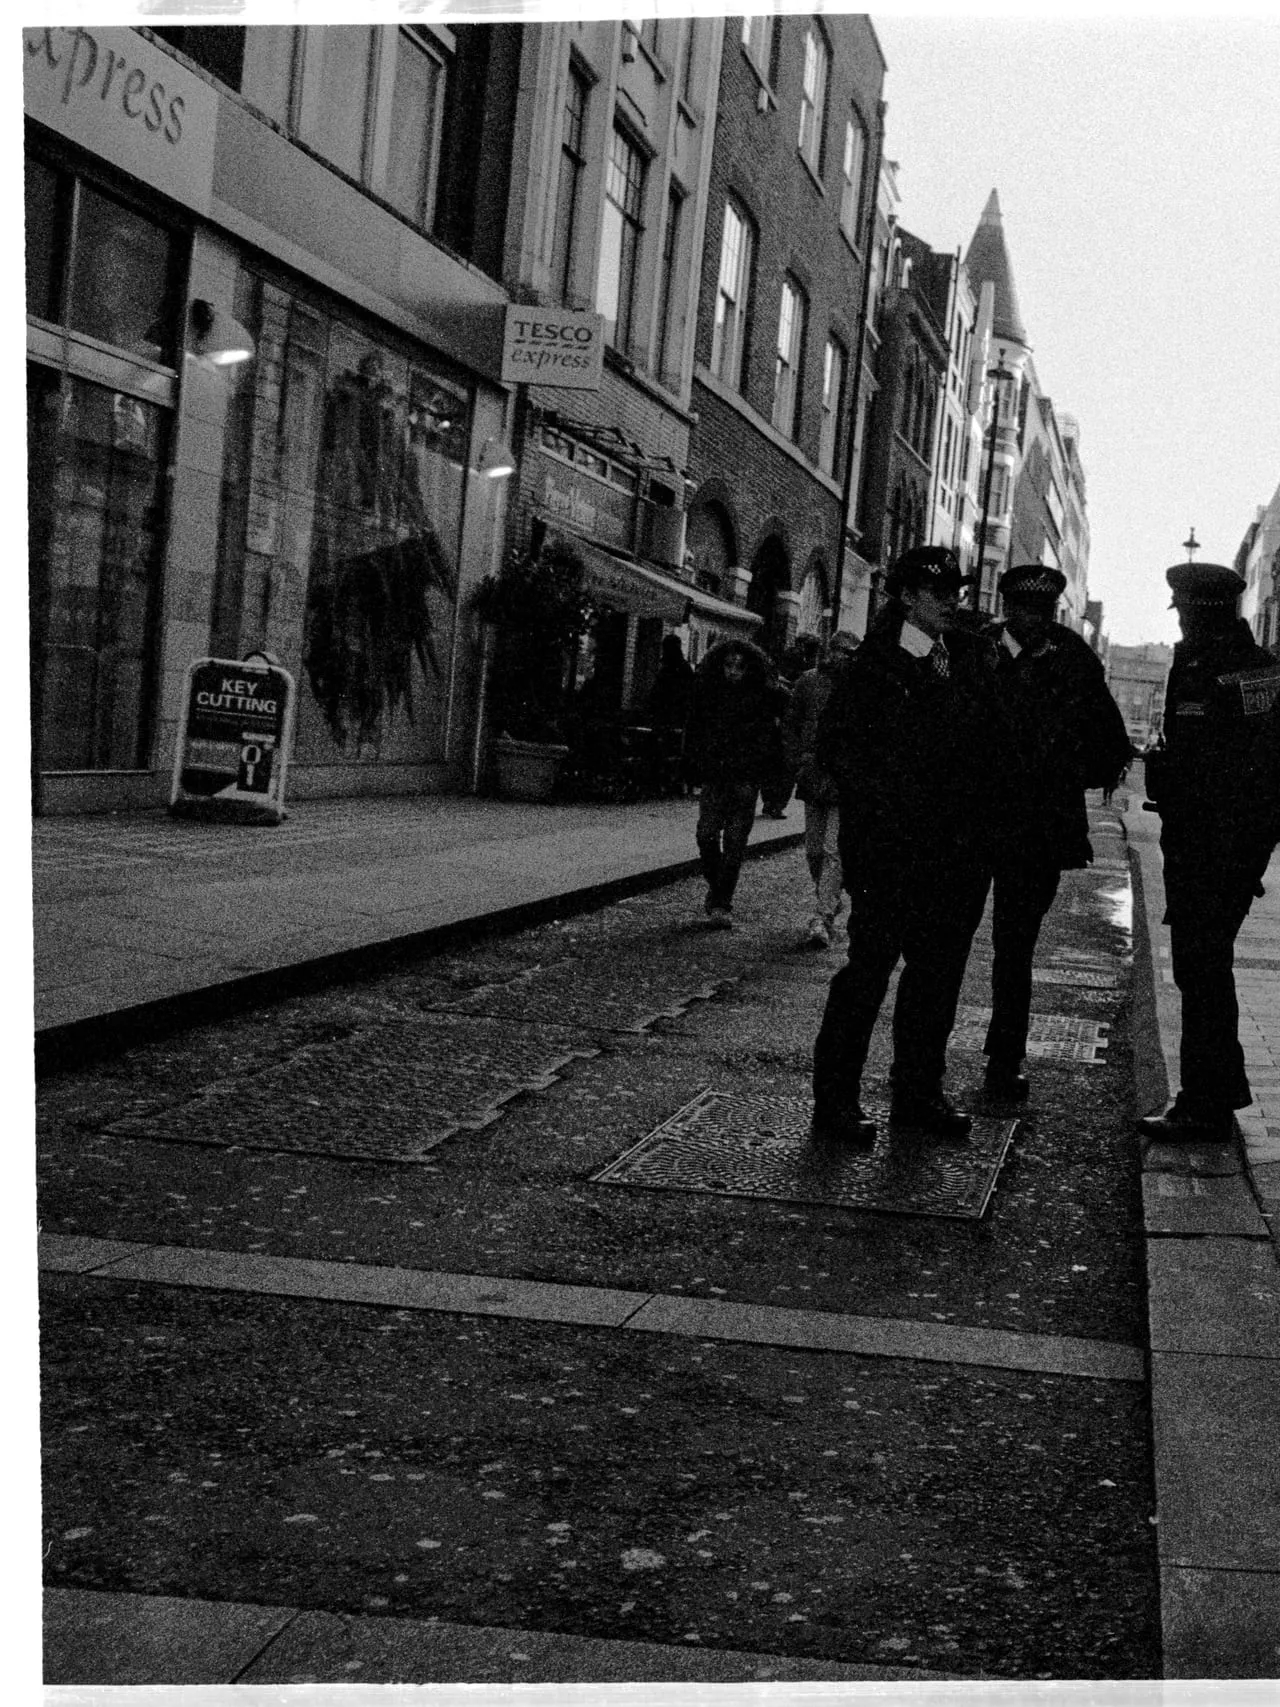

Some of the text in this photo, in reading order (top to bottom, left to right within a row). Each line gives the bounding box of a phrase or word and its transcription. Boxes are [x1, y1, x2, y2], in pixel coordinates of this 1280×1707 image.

[513, 320, 593, 343] TESCO
[511, 350, 591, 370] express
[221, 679, 259, 696] KEY
[196, 691, 277, 714] CUTTING
